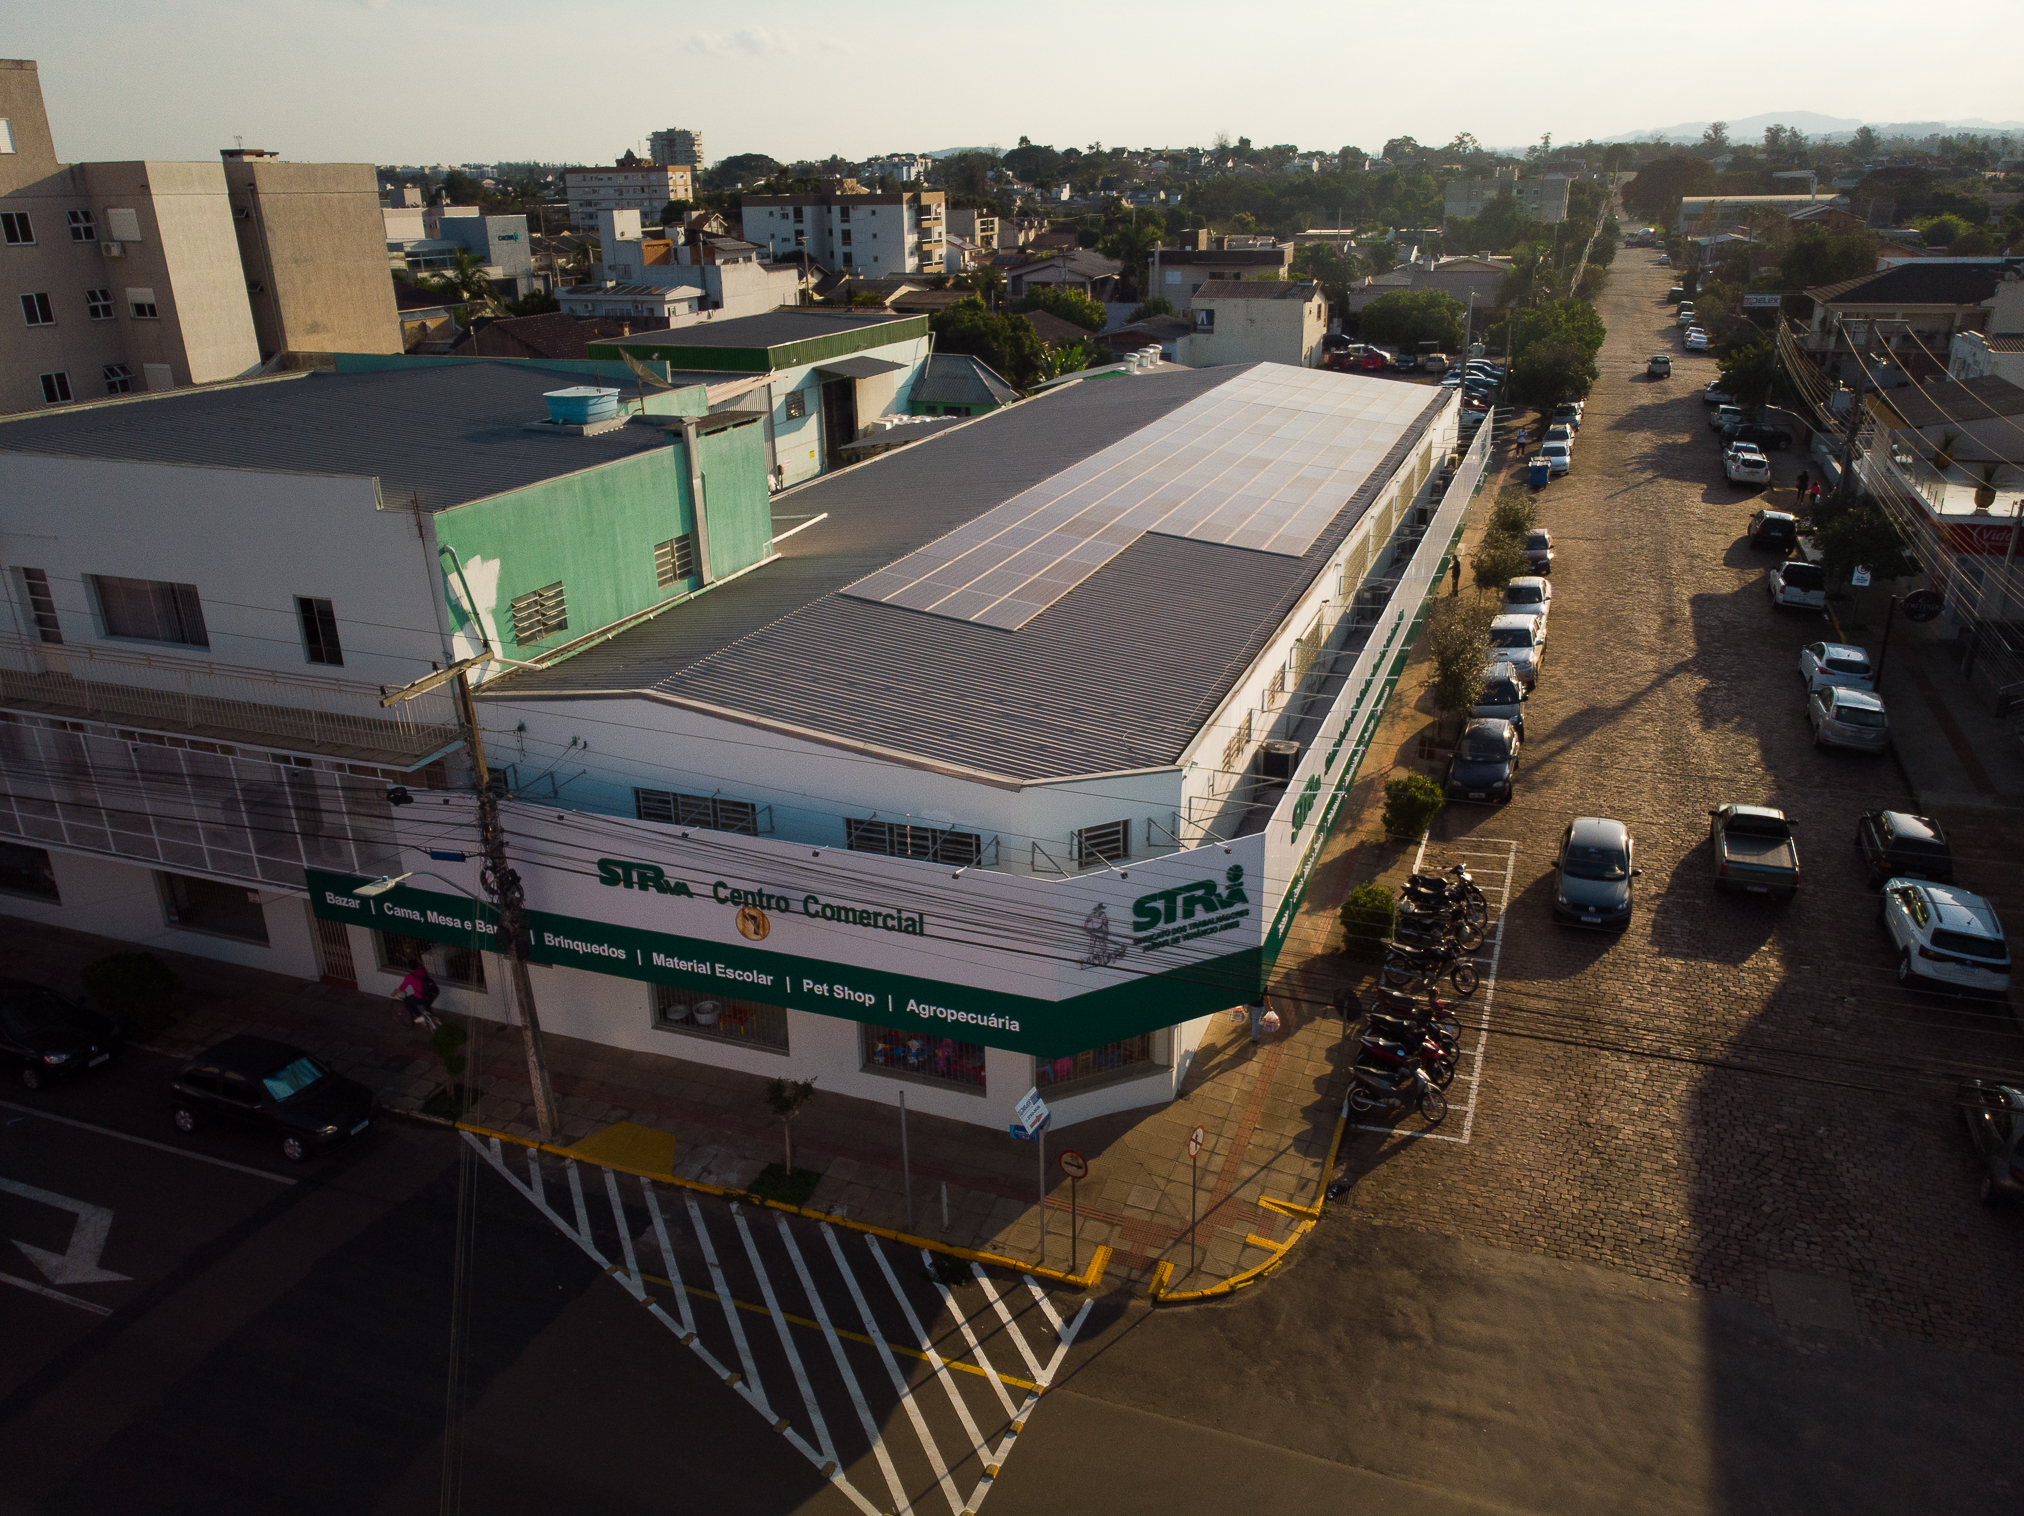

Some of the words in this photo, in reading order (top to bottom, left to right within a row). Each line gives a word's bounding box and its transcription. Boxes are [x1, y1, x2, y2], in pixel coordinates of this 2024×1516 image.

[712, 880, 789, 913] Centro
[803, 893, 925, 936] Comercial
[325, 891, 361, 910] Bazar
[383, 902, 424, 924] Cama,
[426, 910, 462, 929] Mesa
[463, 920, 473, 931] e
[543, 932, 627, 960] Brinquedos
[652, 952, 711, 976] Material
[716, 963, 774, 986] Escolar
[802, 979, 830, 997] Pet
[833, 985, 876, 1007] Shop
[905, 998, 1020, 1033] Agropecuária
